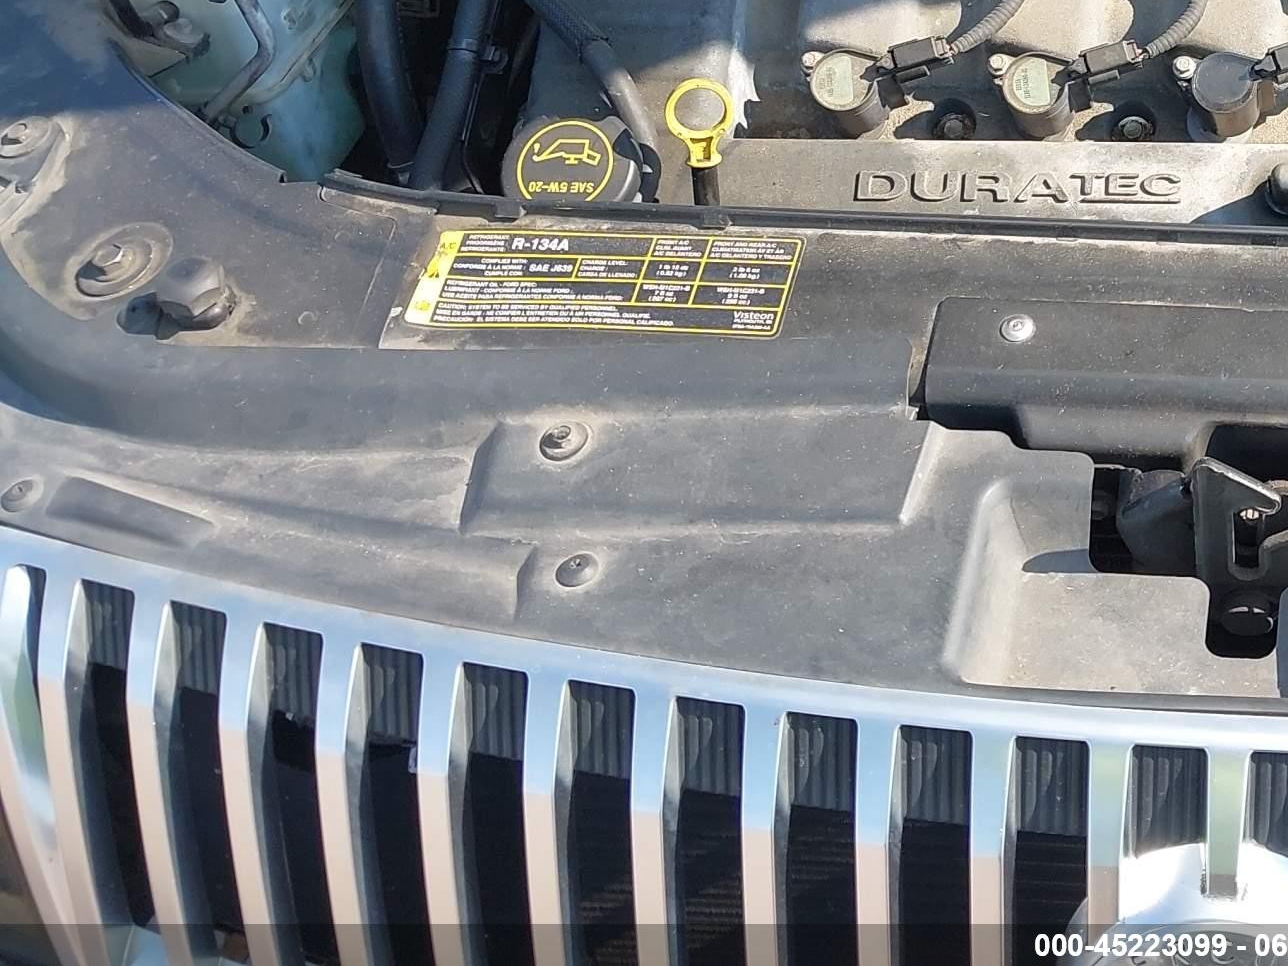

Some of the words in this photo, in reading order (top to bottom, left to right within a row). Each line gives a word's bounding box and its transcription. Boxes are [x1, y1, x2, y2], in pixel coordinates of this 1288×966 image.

[528, 181, 569, 194] 5W-20
[570, 181, 595, 194] SAE
[852, 170, 1182, 204] DURATEC
[511, 237, 569, 251] R-134A
[529, 263, 549, 272] SAE
[733, 310, 774, 320] Visteon
